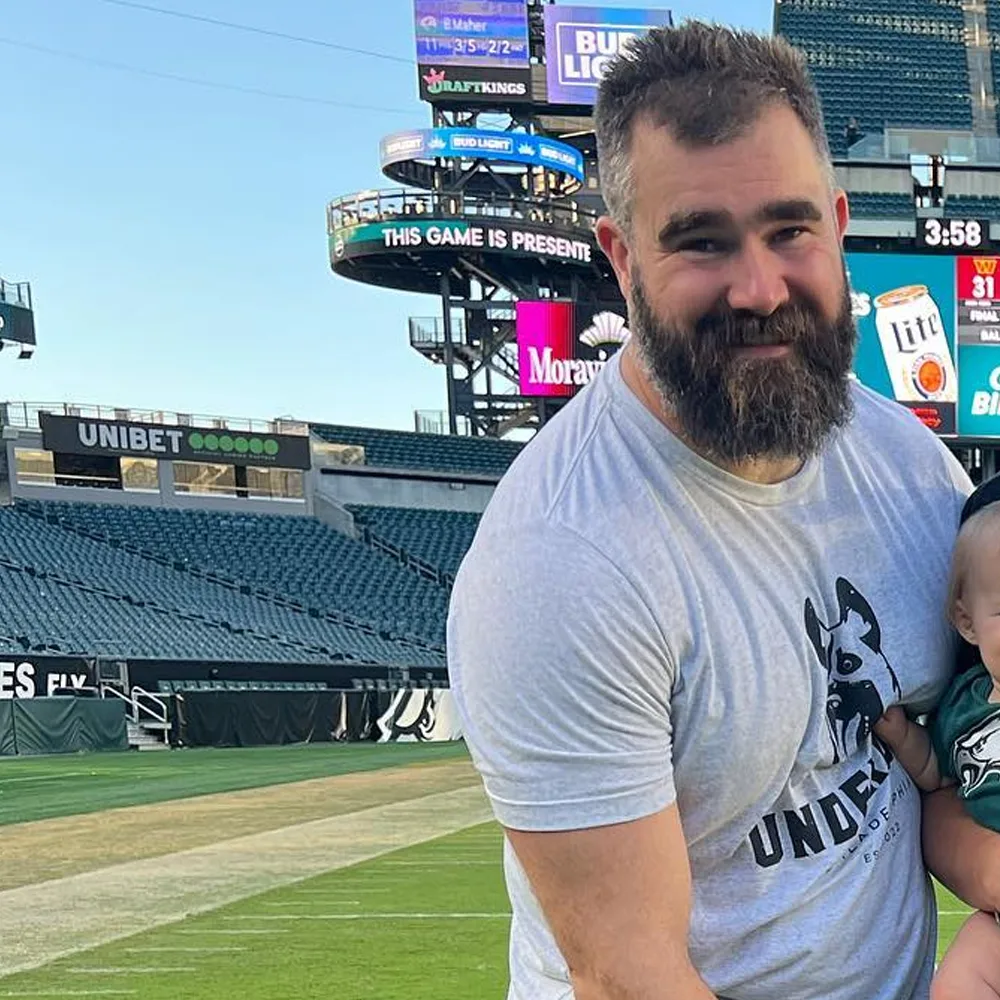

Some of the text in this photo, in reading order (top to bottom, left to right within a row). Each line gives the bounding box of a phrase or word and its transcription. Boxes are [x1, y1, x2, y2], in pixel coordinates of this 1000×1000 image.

[488, 40, 511, 54] 2/2
[382, 227, 422, 248] THIS
[426, 226, 484, 247] GAME
[488, 229, 508, 249] IS
[924, 218, 982, 247] 3:58
[971, 276, 996, 299] 31
[889, 312, 939, 354] Lite
[78, 422, 183, 454] UNIBET
[0, 661, 36, 699] ES
